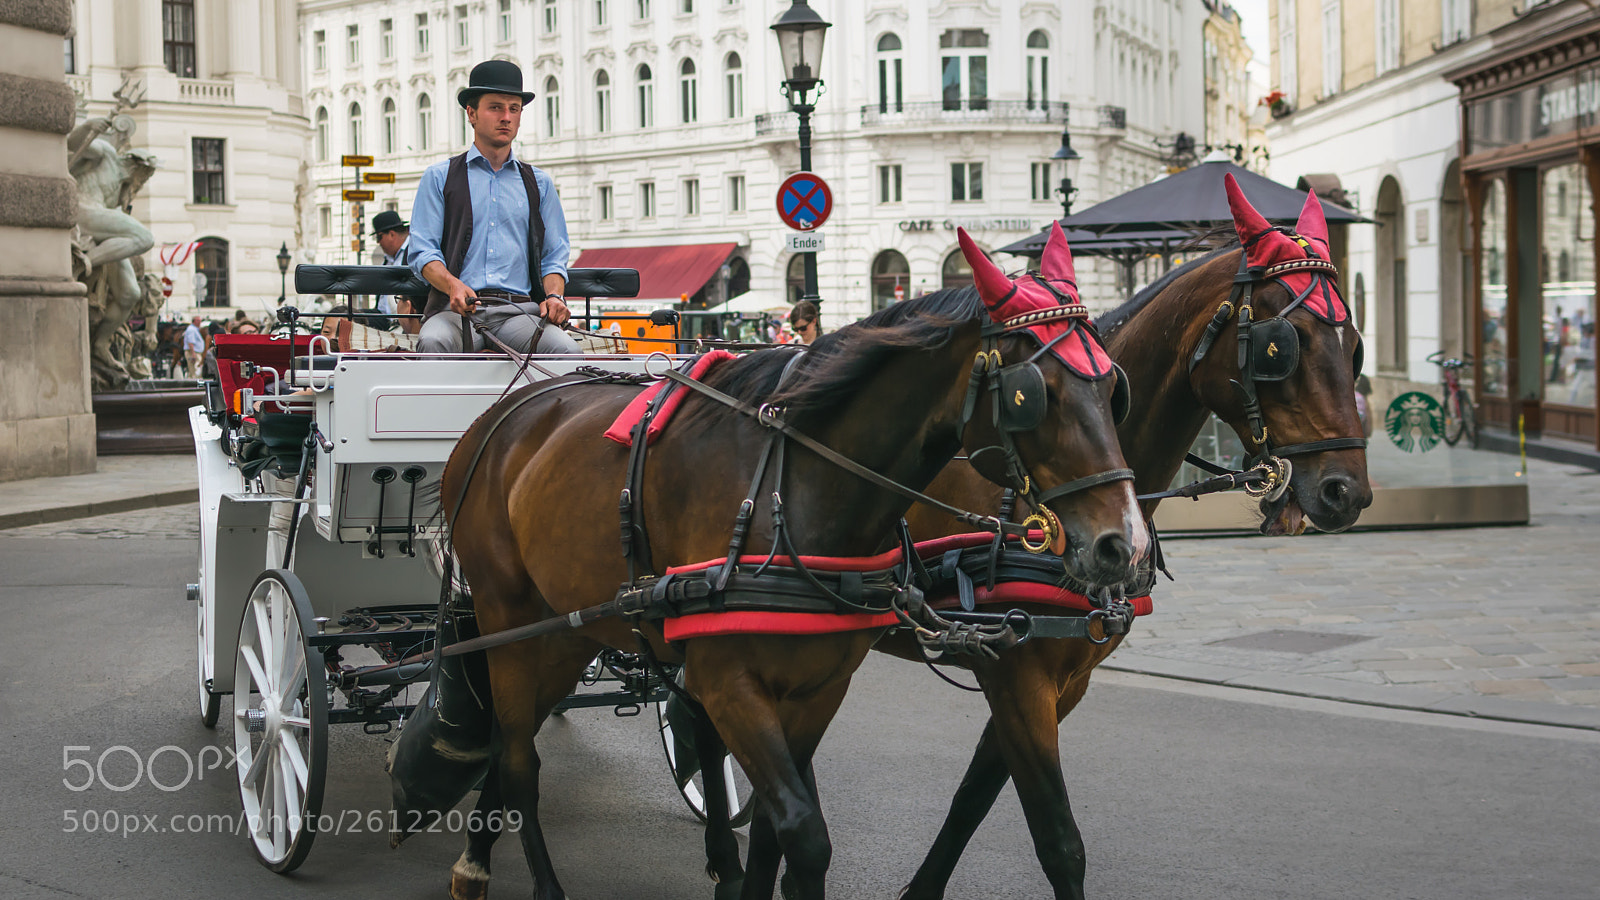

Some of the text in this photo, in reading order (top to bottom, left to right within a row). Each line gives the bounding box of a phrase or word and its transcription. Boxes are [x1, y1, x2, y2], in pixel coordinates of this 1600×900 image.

[1541, 81, 1600, 126] STARBU
[898, 219, 934, 233] CAFE
[793, 236, 817, 249] Ende
